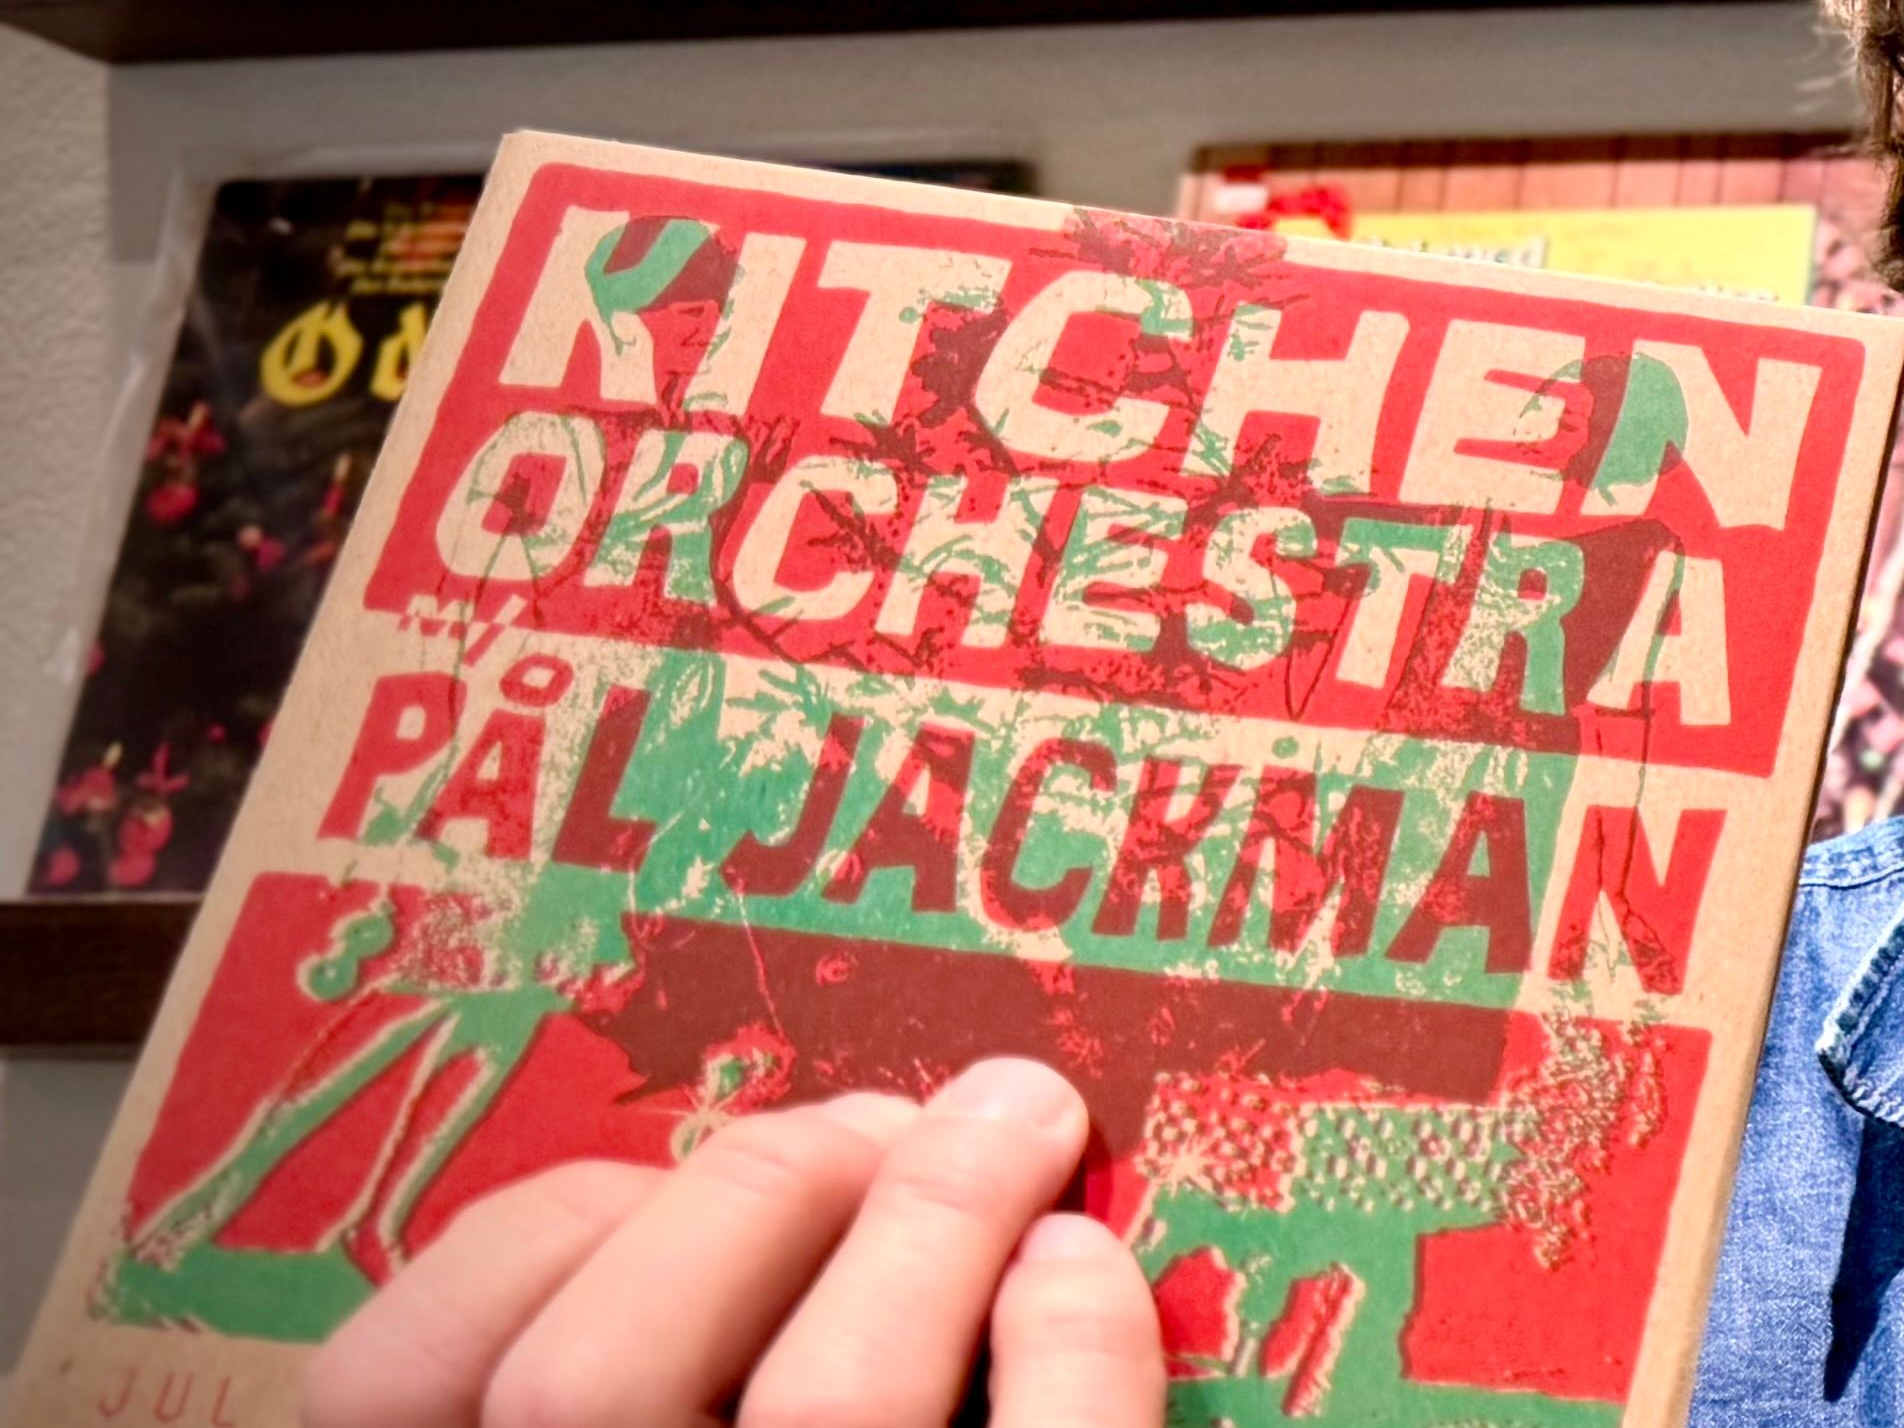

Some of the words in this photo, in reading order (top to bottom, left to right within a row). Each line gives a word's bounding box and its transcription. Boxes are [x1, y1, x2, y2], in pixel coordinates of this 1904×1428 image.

[502, 206, 1822, 531] KITCHEN
[435, 414, 1738, 725] ORCHESTRA
[316, 651, 660, 873] PÅL
[732, 702, 1728, 996] JACKMAN
